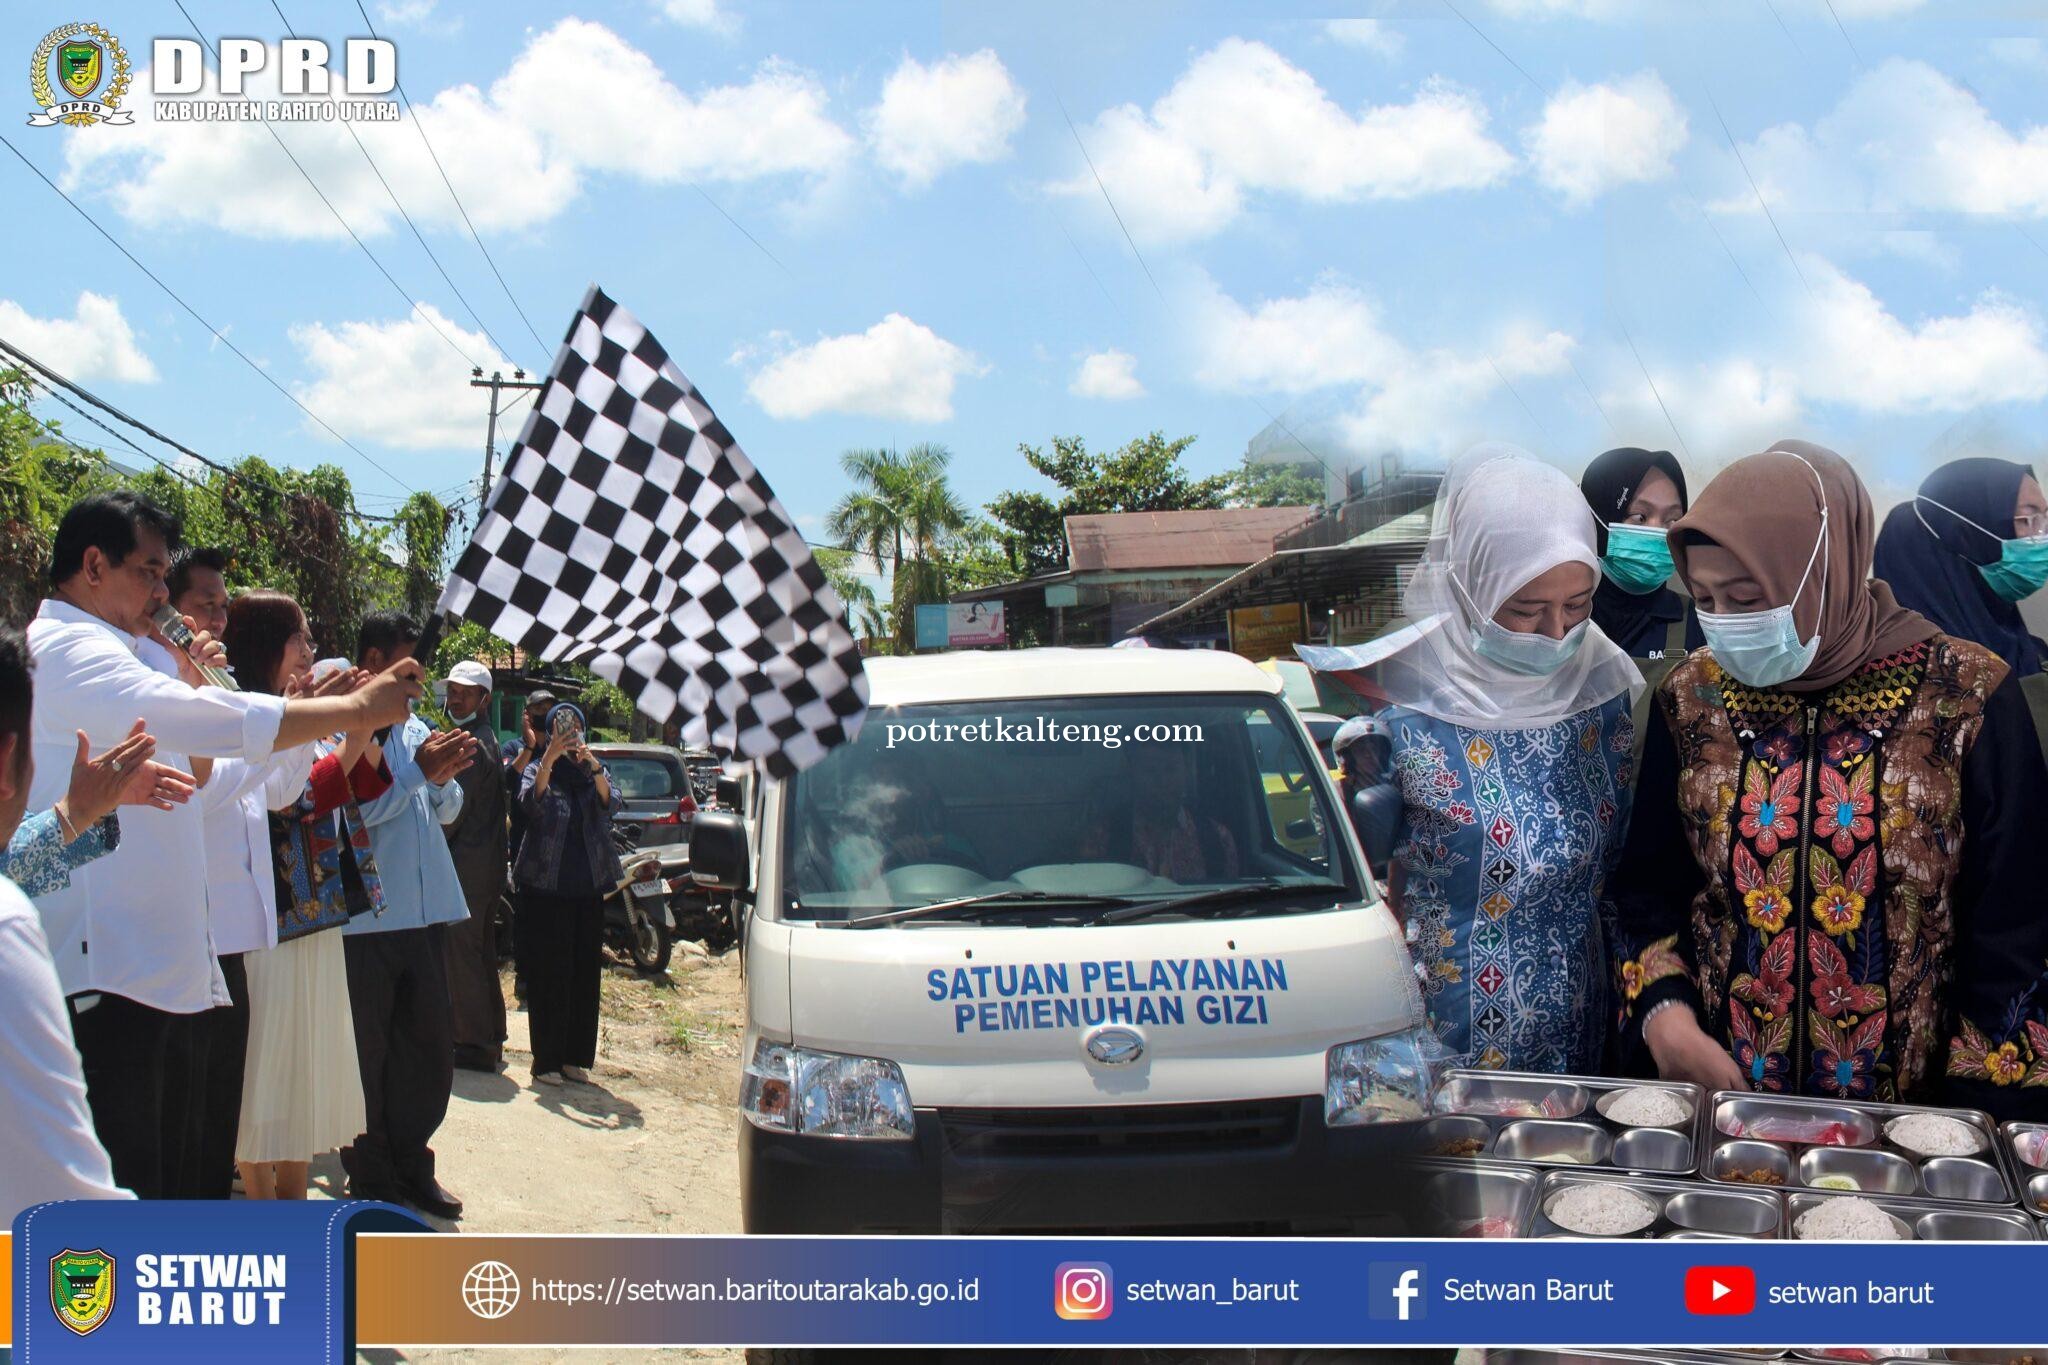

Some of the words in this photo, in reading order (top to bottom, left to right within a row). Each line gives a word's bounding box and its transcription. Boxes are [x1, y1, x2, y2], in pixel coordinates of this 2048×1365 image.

[927, 963, 1067, 1001] SATUAN
[1080, 959, 1288, 993] PELAYANAN
[955, 996, 1184, 1033] PEMENUHAN
[1197, 995, 1268, 1025] GIZI
